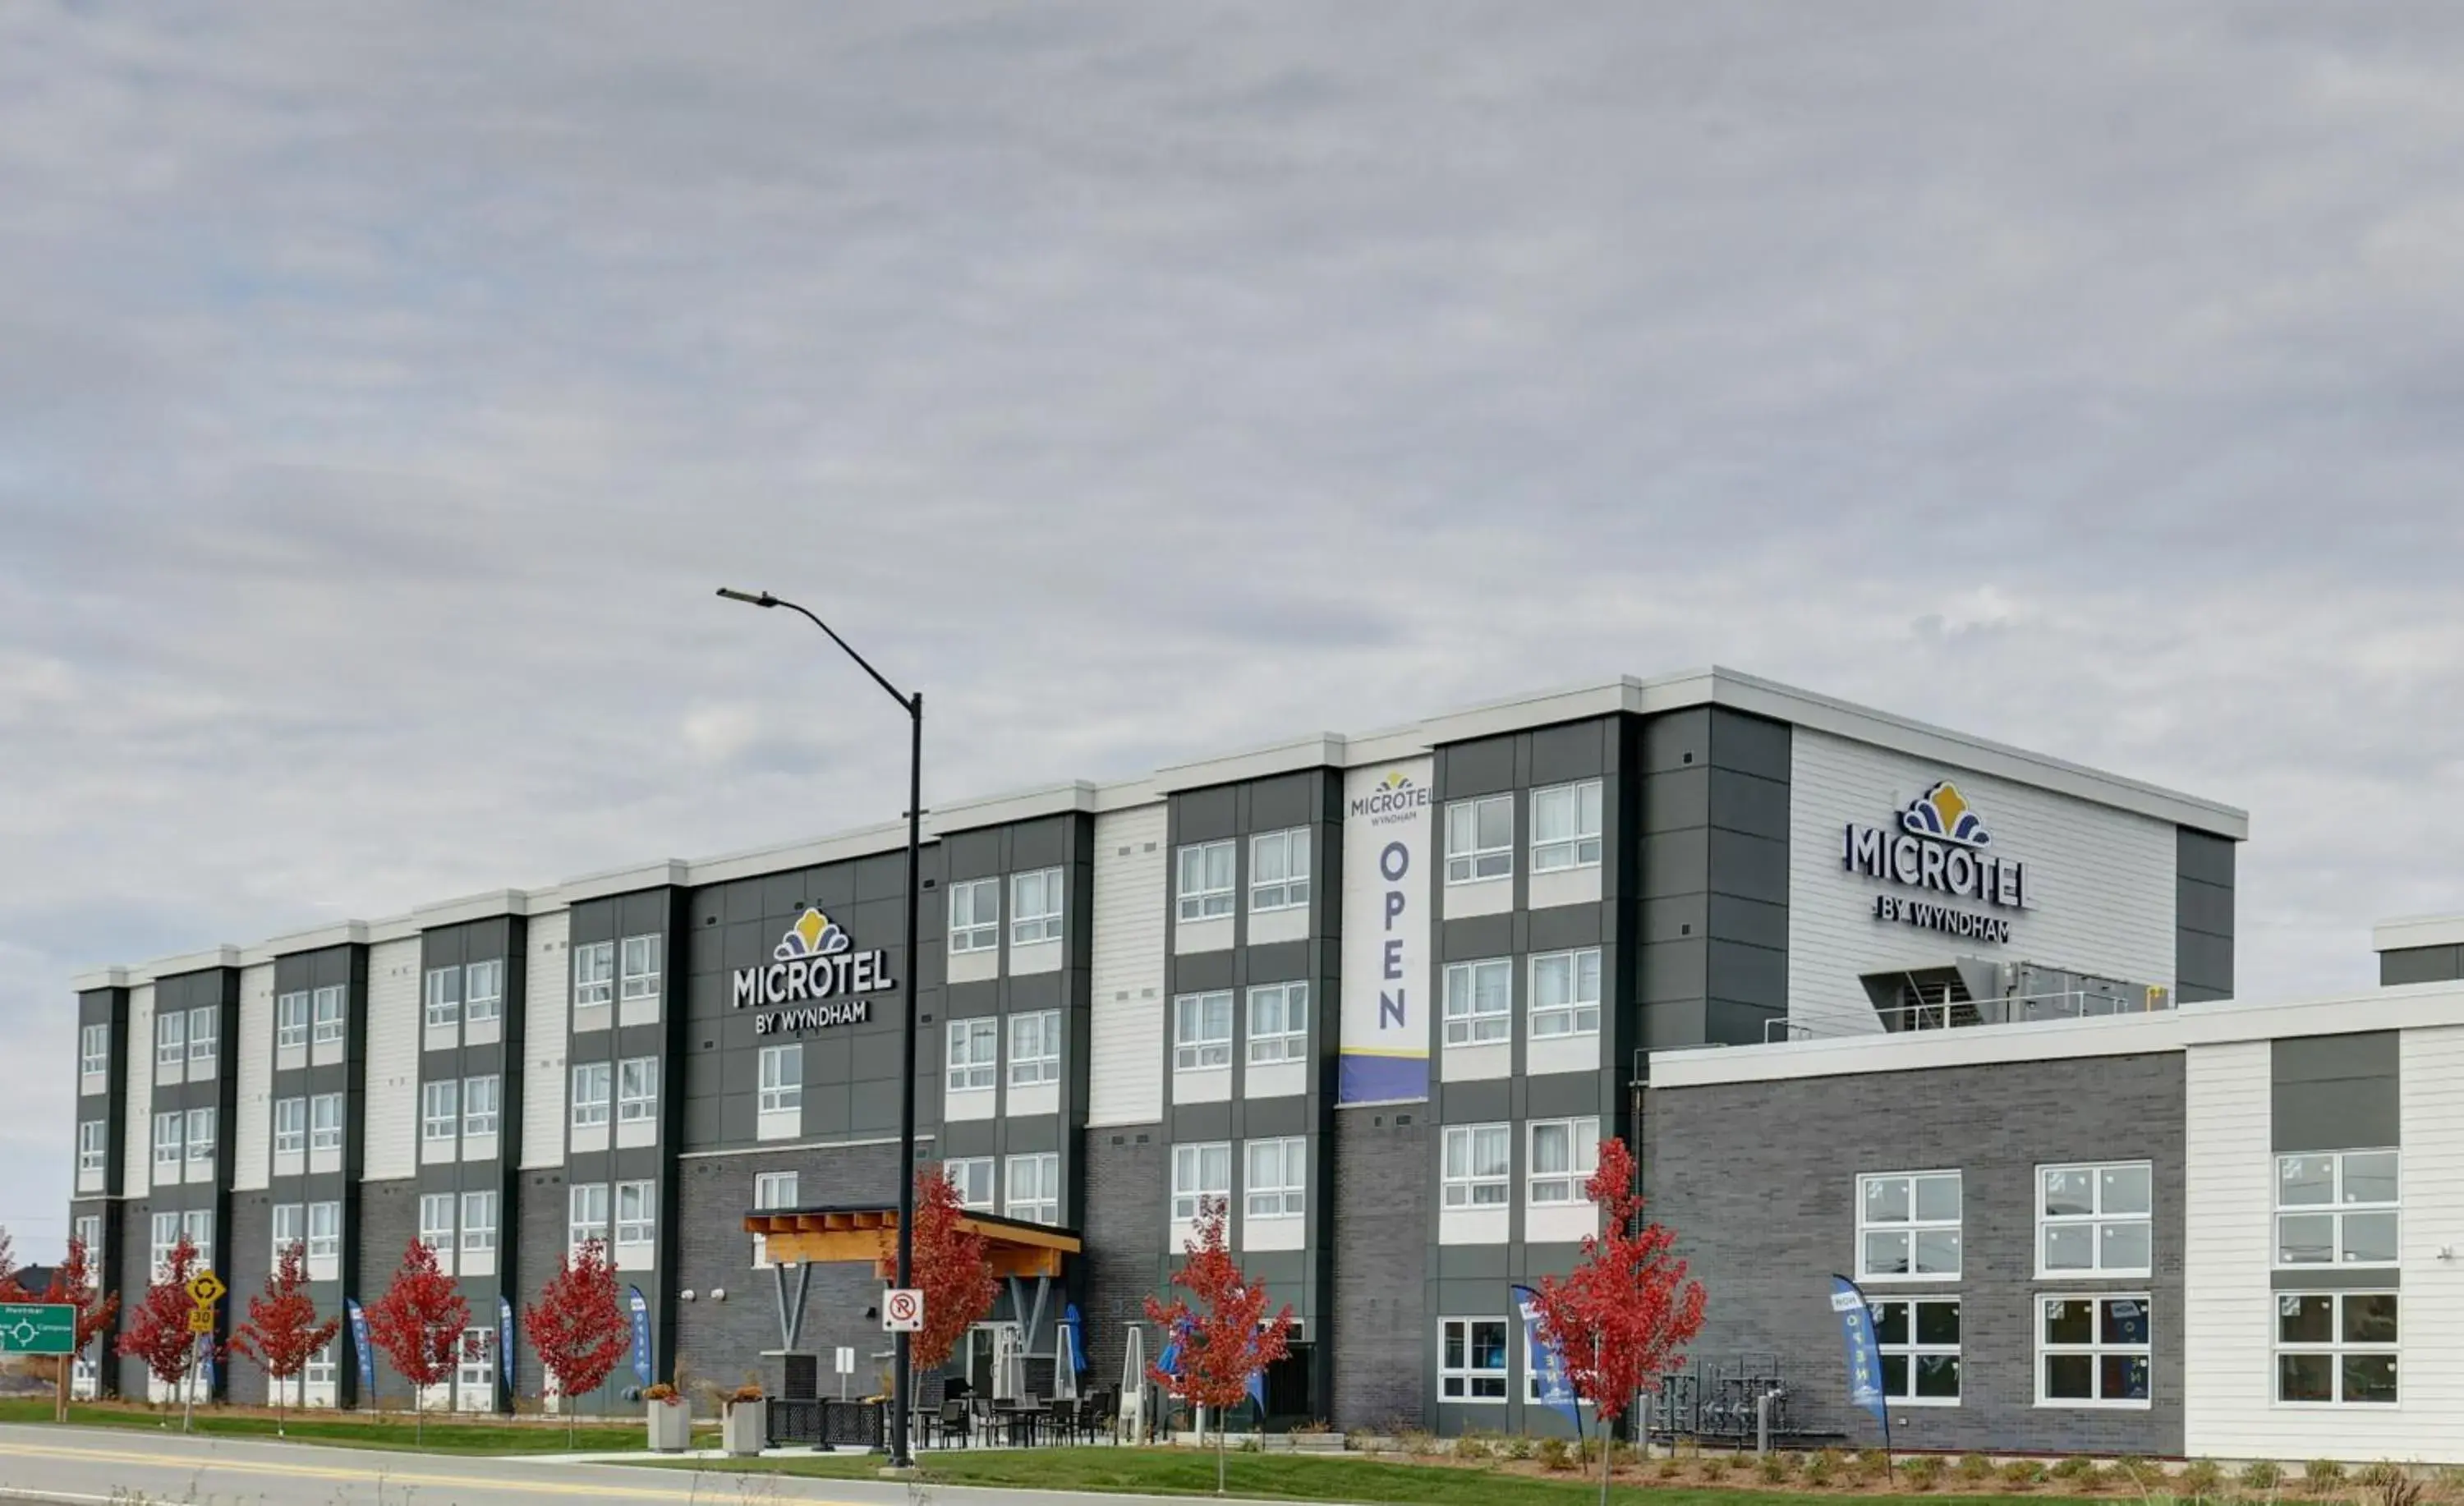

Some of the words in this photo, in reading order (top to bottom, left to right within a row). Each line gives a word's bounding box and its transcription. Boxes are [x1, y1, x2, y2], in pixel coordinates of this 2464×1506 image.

[1351, 788, 1432, 817] MICROTEL
[1850, 824, 2039, 911] MICROTEL
[1379, 841, 1409, 1031] OPEN
[1880, 895, 1905, 921] BY
[1915, 902, 2010, 944] WYNDHAM
[733, 949, 892, 1008] MICROTEL
[756, 1012, 775, 1034] BY
[781, 1000, 866, 1031] WYNDHAM
[193, 1311, 211, 1323] 30
